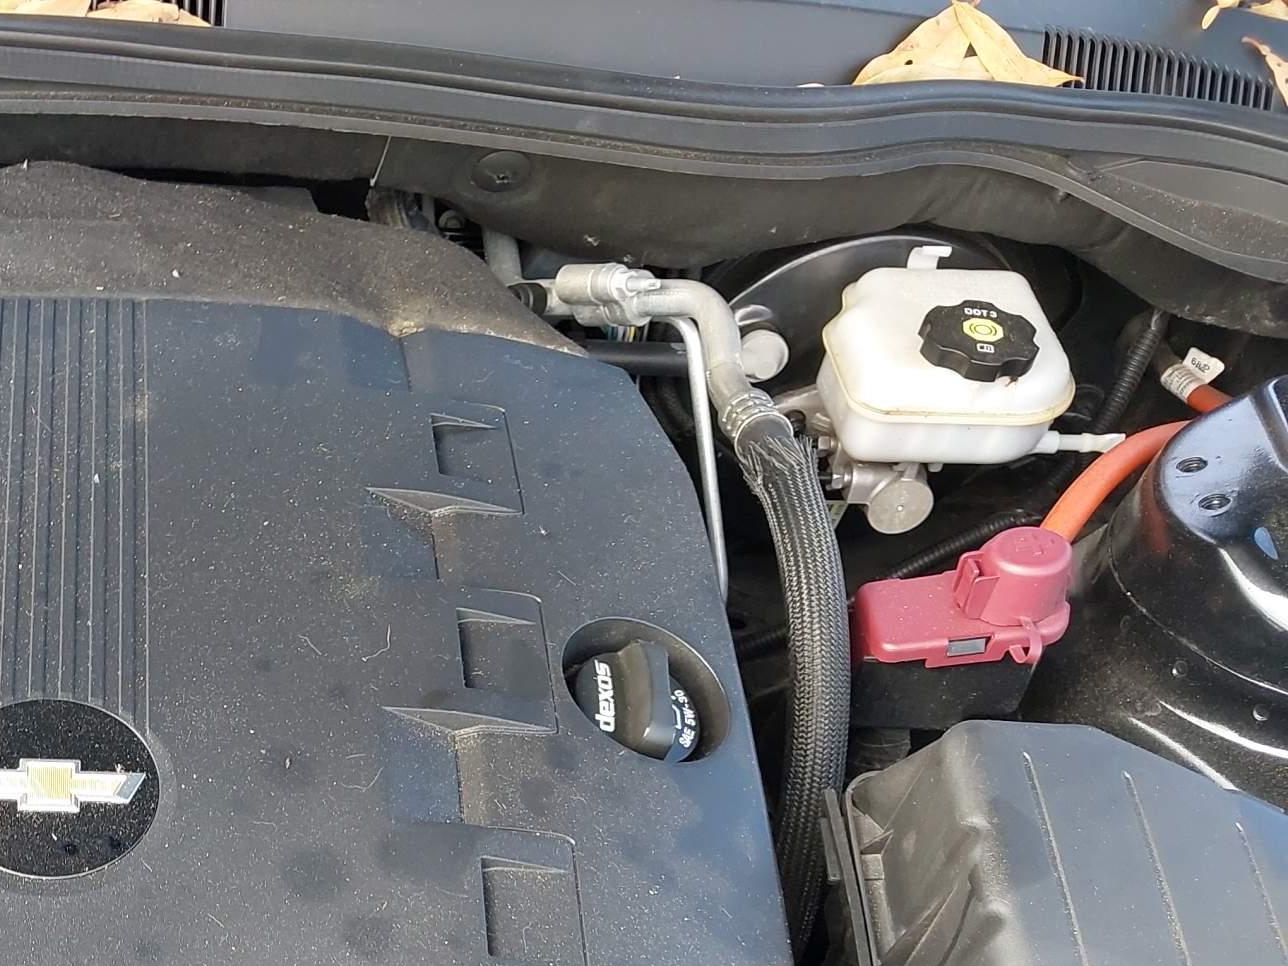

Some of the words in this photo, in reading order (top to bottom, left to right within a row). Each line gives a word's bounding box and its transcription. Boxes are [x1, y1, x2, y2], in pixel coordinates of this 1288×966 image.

[964, 307, 988, 317] DOT
[989, 310, 998, 318] 3
[594, 659, 616, 733] dexos
[678, 726, 697, 748] SAE
